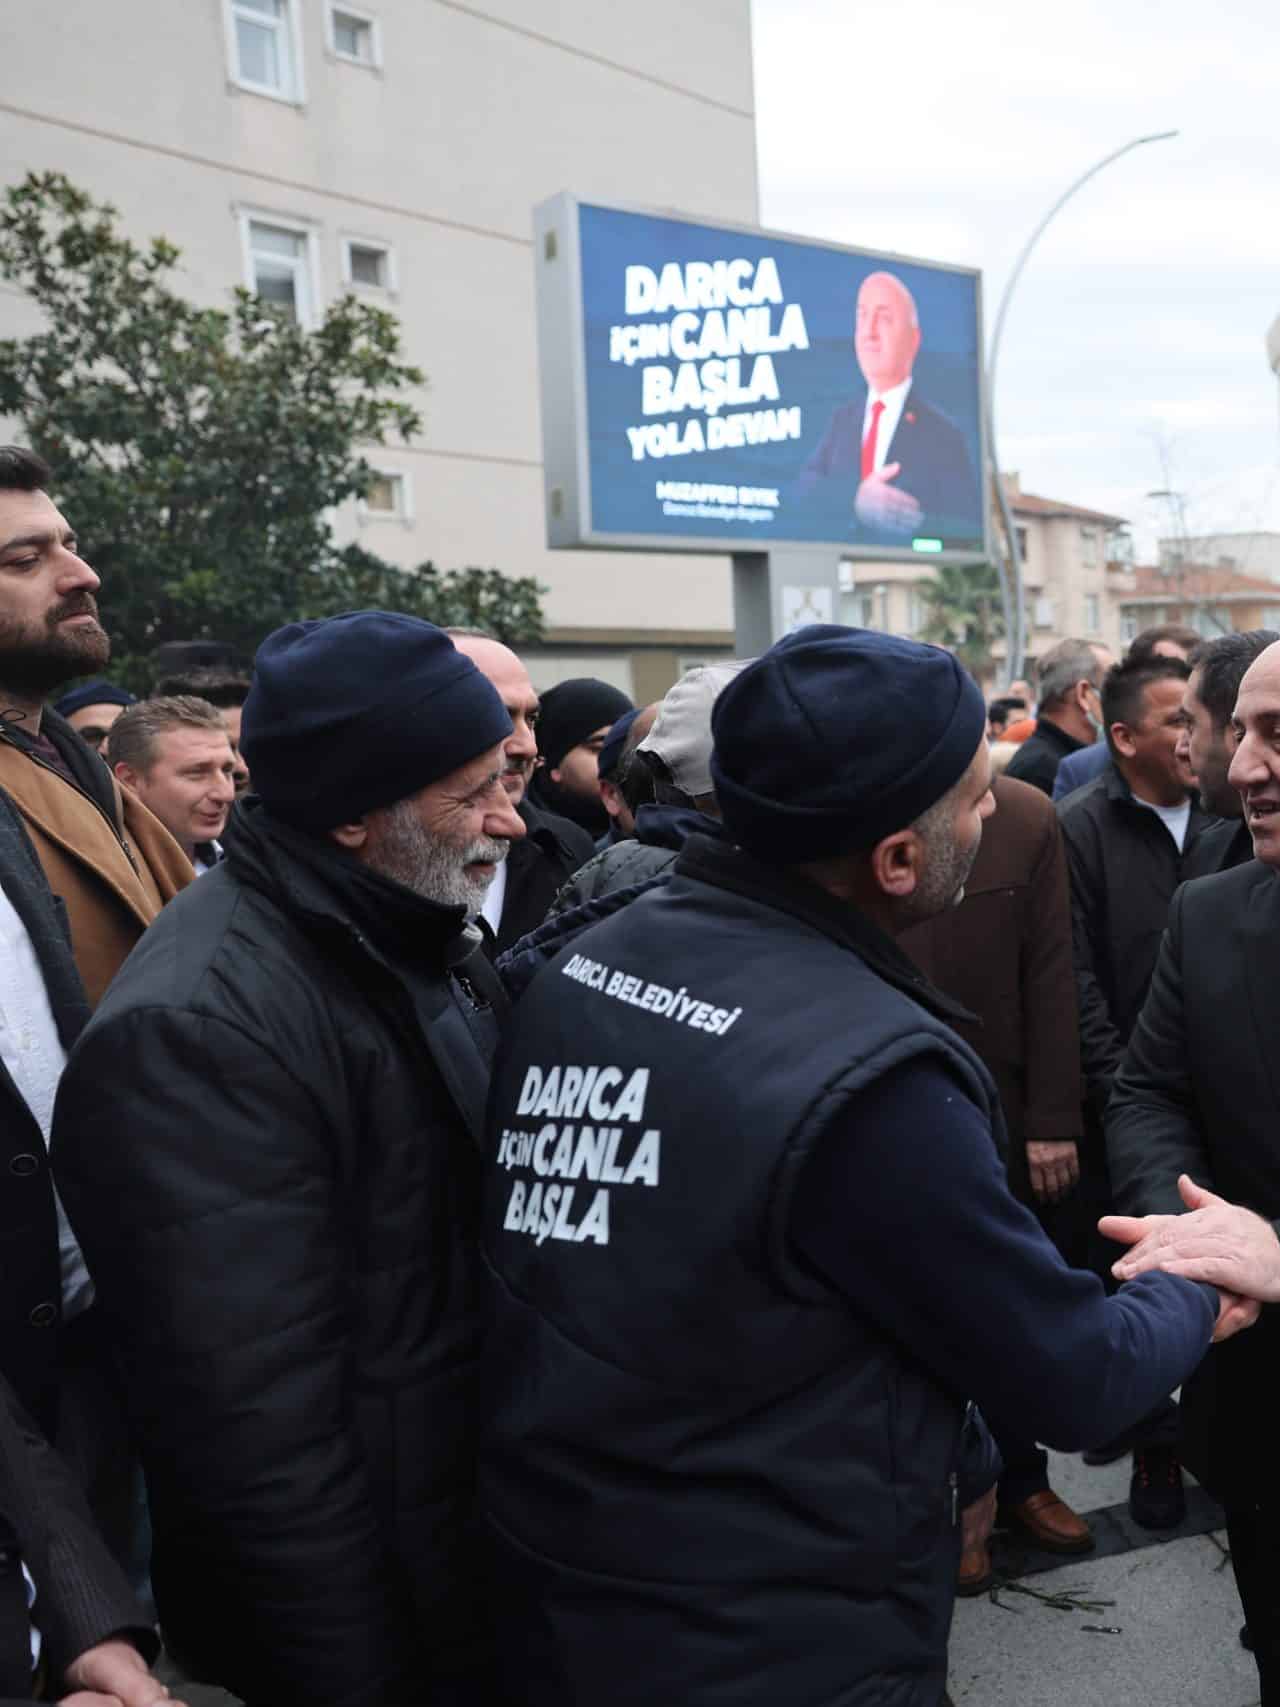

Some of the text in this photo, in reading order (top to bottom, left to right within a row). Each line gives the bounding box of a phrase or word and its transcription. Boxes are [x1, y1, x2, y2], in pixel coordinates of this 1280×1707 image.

[626, 257, 783, 315] DARICA
[670, 304, 809, 361] CANLA
[643, 355, 780, 416] BAŞLA
[626, 406, 801, 461] YOLA DEVAM
[562, 953, 743, 1036] DARICA BELEDİYESİ
[516, 1065, 650, 1123] DARICA
[532, 1123, 661, 1187] CANLA
[503, 1180, 610, 1247] BAŞLA
